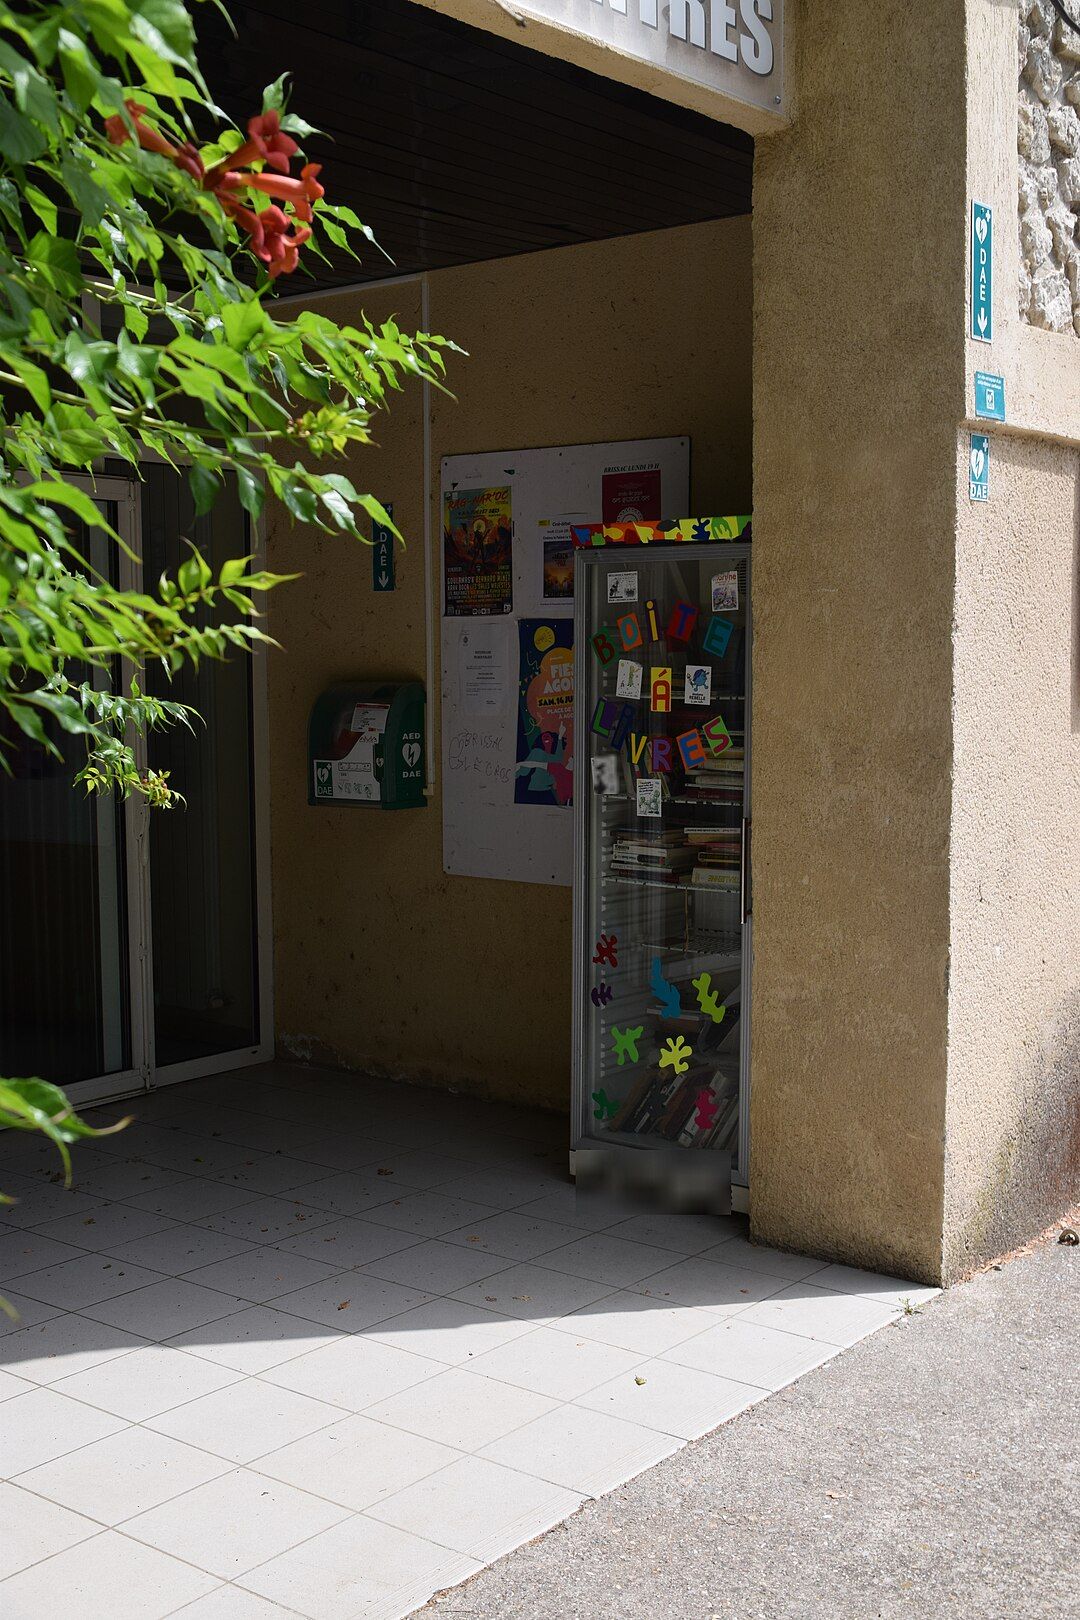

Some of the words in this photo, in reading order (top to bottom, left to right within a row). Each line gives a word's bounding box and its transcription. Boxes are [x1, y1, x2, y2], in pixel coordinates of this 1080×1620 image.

[970, 483, 987, 499] DAE
[402, 732, 421, 740] AED
[402, 770, 421, 778] DAE
[318, 786, 333, 796] DAE
